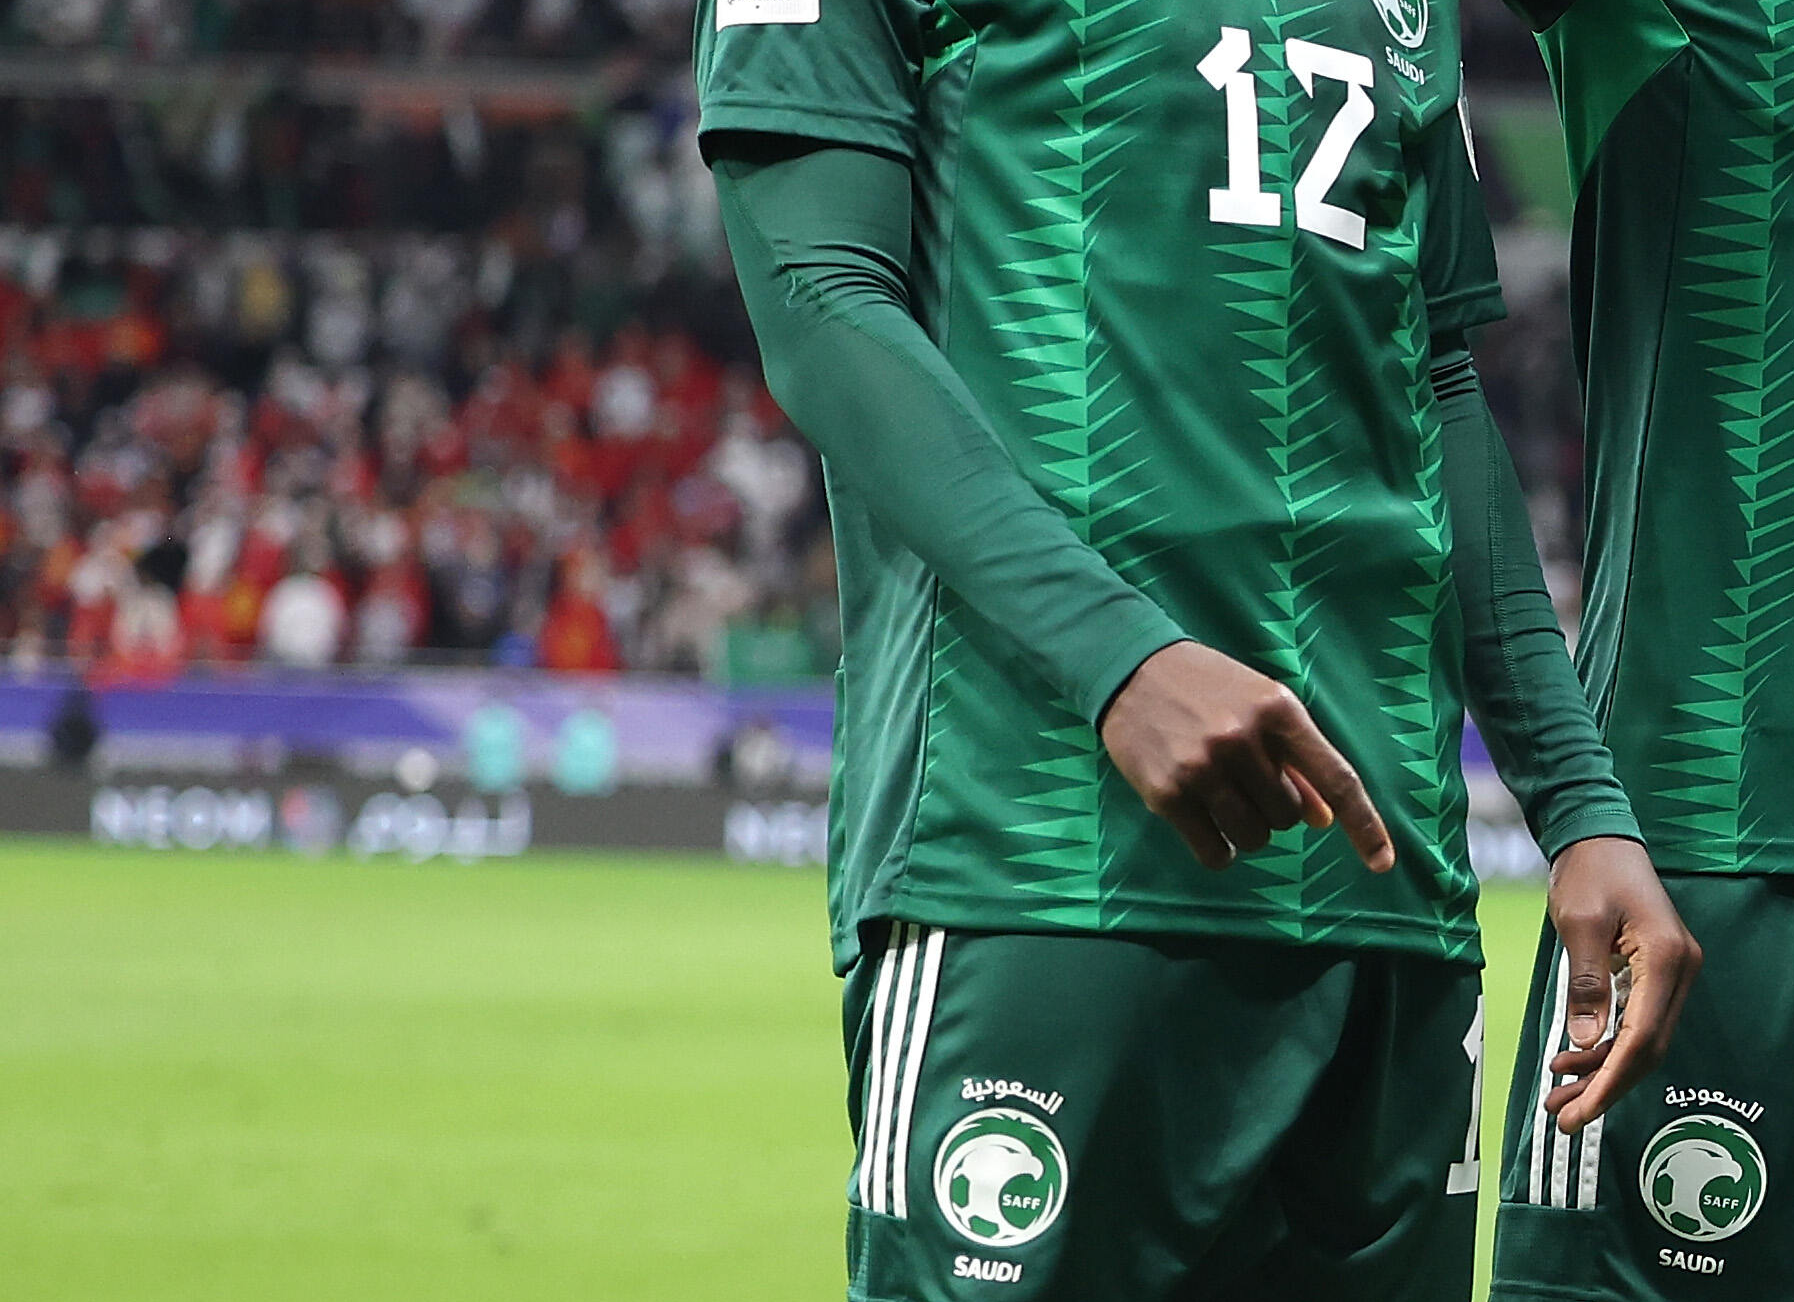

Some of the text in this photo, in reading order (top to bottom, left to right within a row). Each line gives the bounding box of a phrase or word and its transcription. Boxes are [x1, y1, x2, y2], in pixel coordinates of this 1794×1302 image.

[1385, 46, 1425, 85] SAUDI
[1197, 26, 1375, 250] 12
[961, 1077, 1064, 1115] السعودية
[1665, 1085, 1765, 1123] السعودية
[1002, 1194, 1041, 1210] SAFF
[1703, 1194, 1739, 1210] SAFF
[953, 1255, 1022, 1283] SAUDI
[1658, 1248, 1726, 1276] SAUDI
